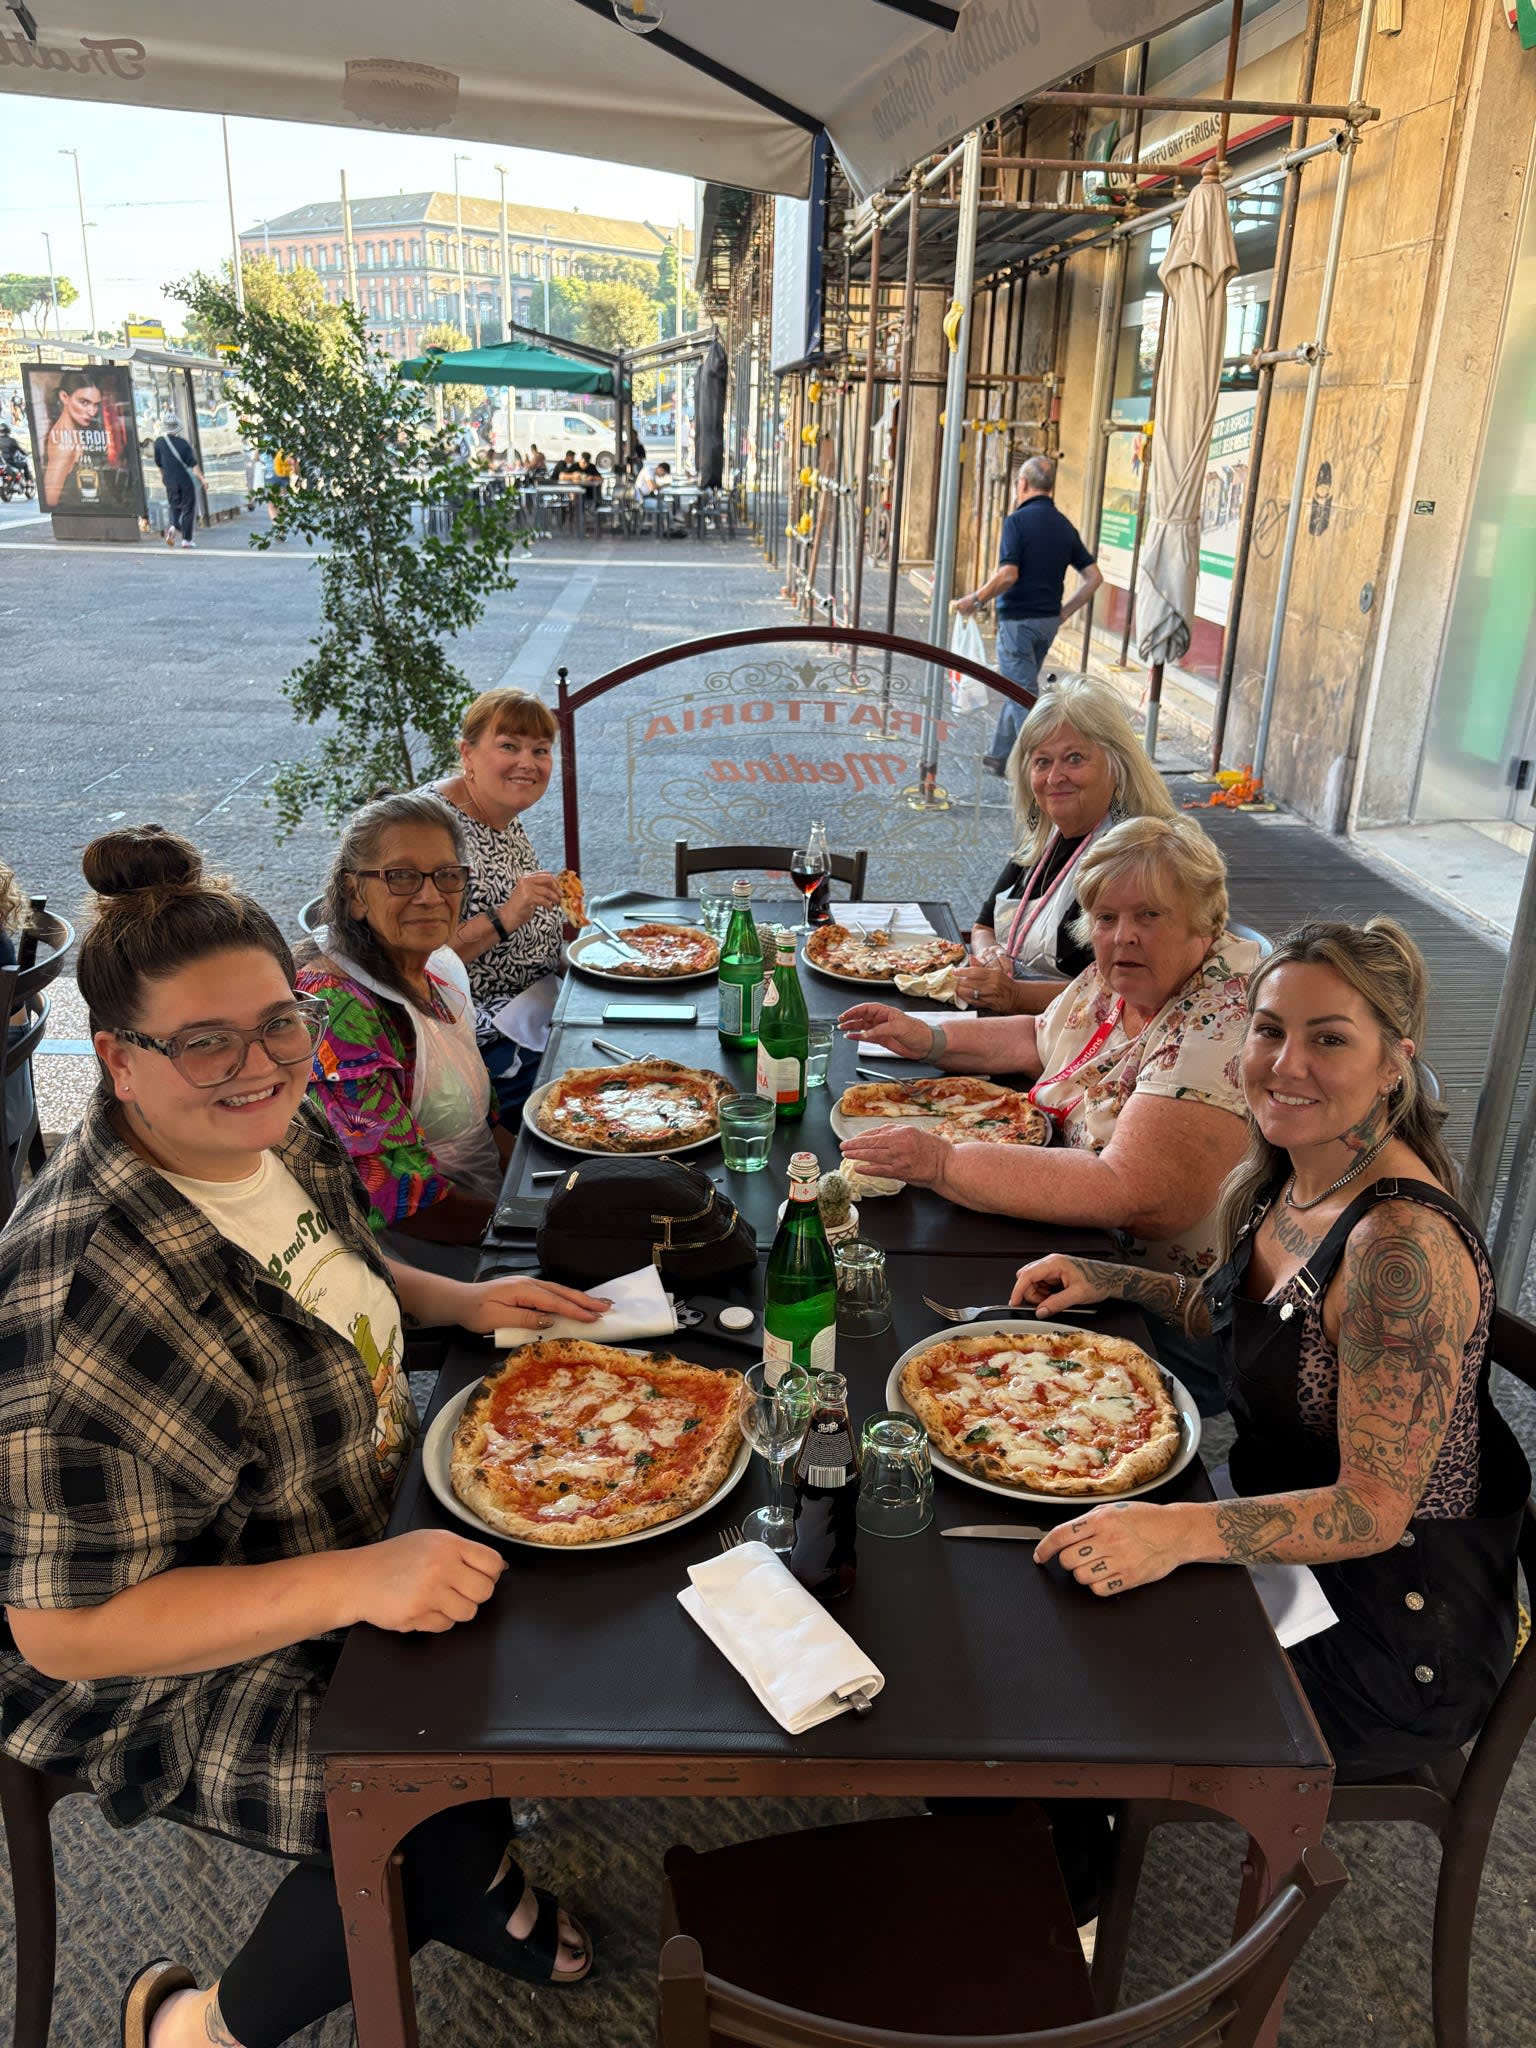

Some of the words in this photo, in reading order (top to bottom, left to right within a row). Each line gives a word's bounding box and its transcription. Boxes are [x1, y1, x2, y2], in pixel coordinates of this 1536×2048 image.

[1184, 114, 1220, 149] PARIBAS
[51, 429, 112, 446] L'INTERDIT
[1065, 1036, 1103, 1075] Vacations
[283, 1231, 305, 1265] and
